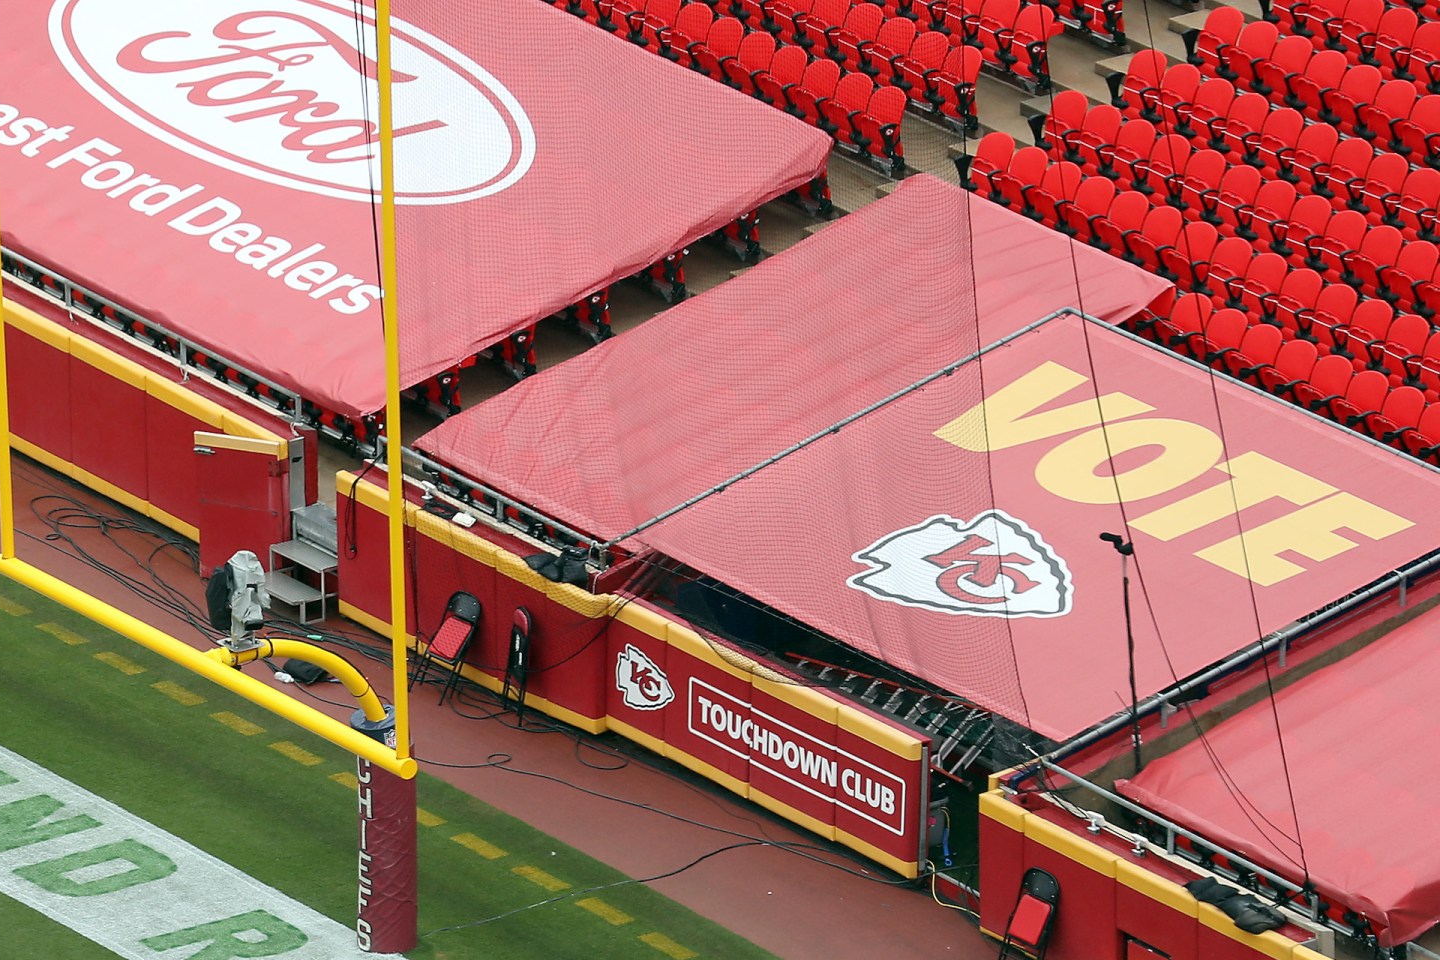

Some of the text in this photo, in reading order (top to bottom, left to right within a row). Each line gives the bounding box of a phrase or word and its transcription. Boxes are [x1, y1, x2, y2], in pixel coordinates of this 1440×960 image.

[116, 10, 449, 164] Ford
[46, 137, 204, 216] Ford
[168, 196, 385, 314] Dealers
[931, 360, 1417, 587] VOTE
[697, 695, 896, 815] TOUCHDOWN CLUB
[356, 755, 374, 952] CHIEFS
